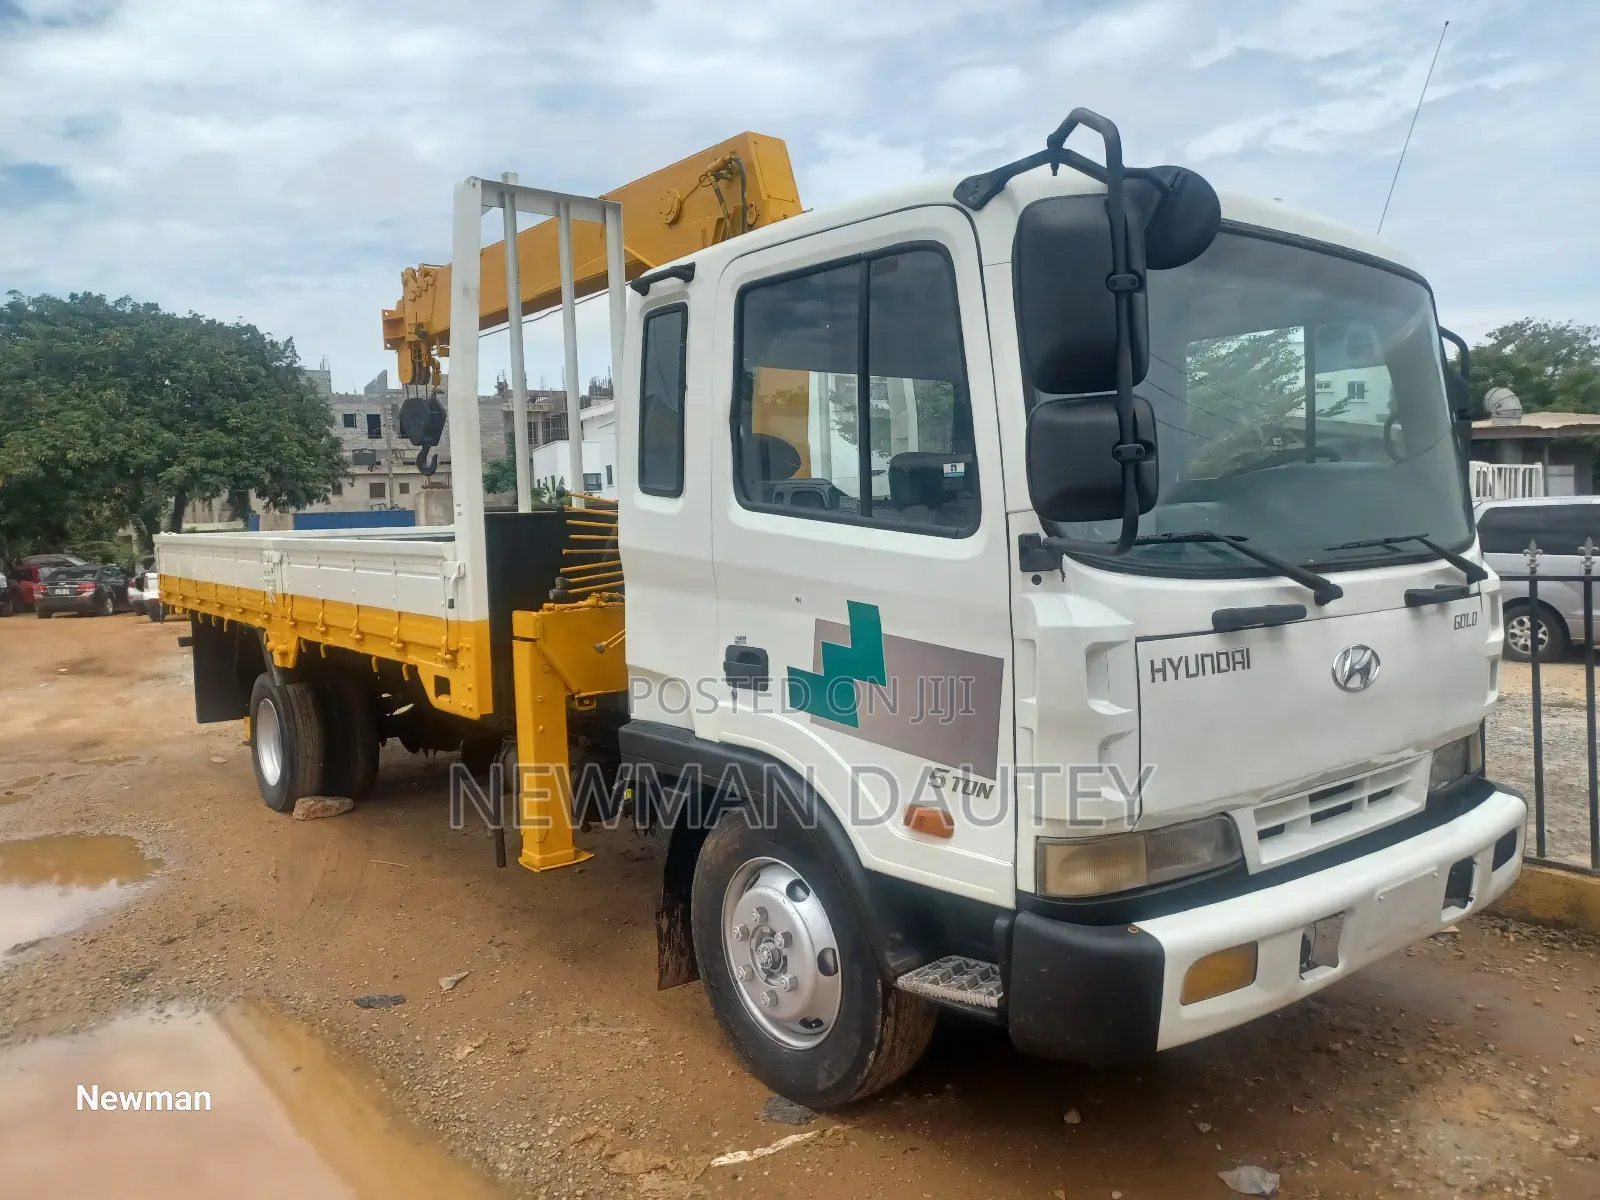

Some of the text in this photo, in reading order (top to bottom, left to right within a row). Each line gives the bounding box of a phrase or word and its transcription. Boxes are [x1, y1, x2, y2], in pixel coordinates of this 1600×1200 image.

[1453, 611, 1478, 630] GOLD
[1150, 646, 1251, 683] HYUNDAI
[928, 767, 995, 800] 5 TON
